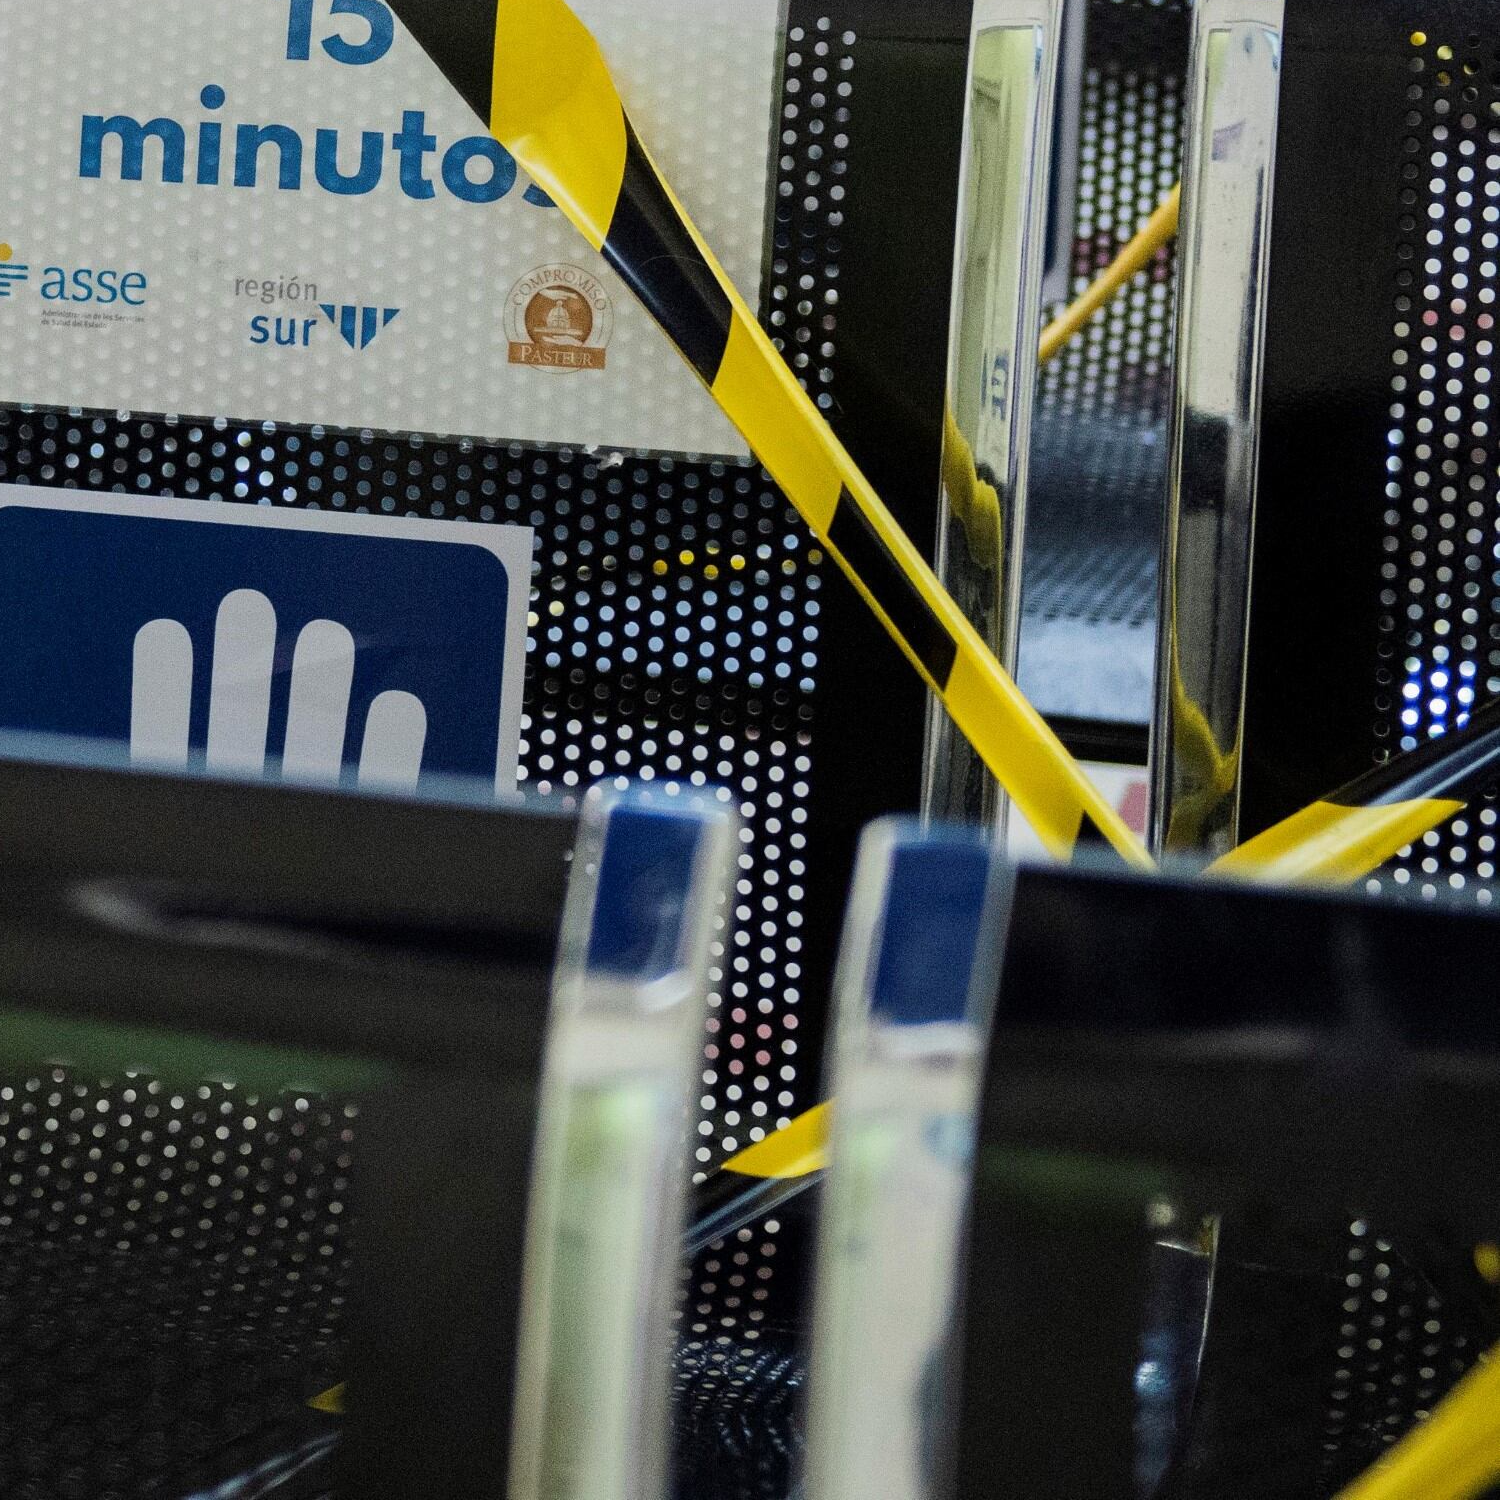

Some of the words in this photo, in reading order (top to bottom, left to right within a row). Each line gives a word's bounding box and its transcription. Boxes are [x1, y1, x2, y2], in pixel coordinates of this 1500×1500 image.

[79, 84, 558, 208] minuto
[40, 266, 147, 305] asse
[234, 275, 318, 304] región
[512, 269, 606, 311] COMPROMISO
[249, 314, 317, 347] sur
